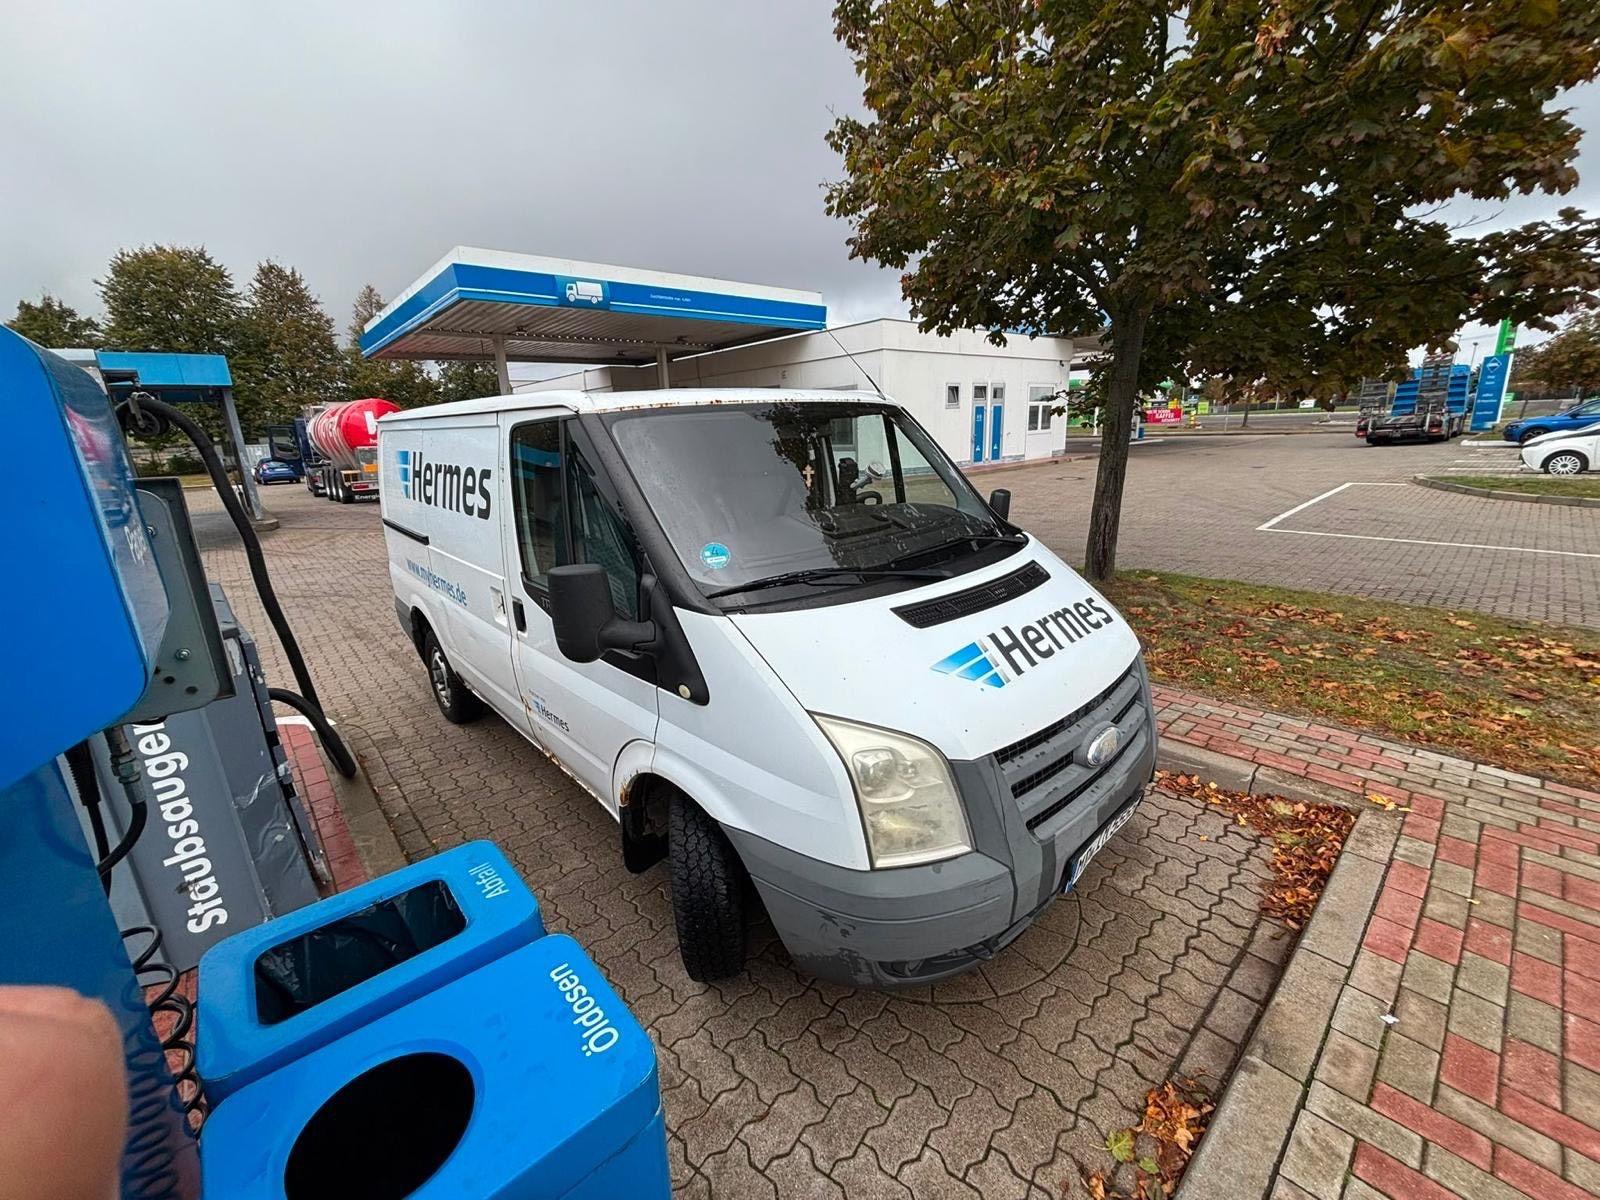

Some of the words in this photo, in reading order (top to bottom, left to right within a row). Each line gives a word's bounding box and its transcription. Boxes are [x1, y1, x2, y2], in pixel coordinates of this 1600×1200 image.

[411, 451, 492, 520] Hermes
[405, 558, 468, 607] www.myhermes.de
[987, 597, 1114, 676] Hermes
[540, 704, 570, 733] Hermes
[131, 722, 229, 934] Staubsauger
[468, 861, 510, 899] Abfall
[549, 963, 619, 1057] Öldosen
